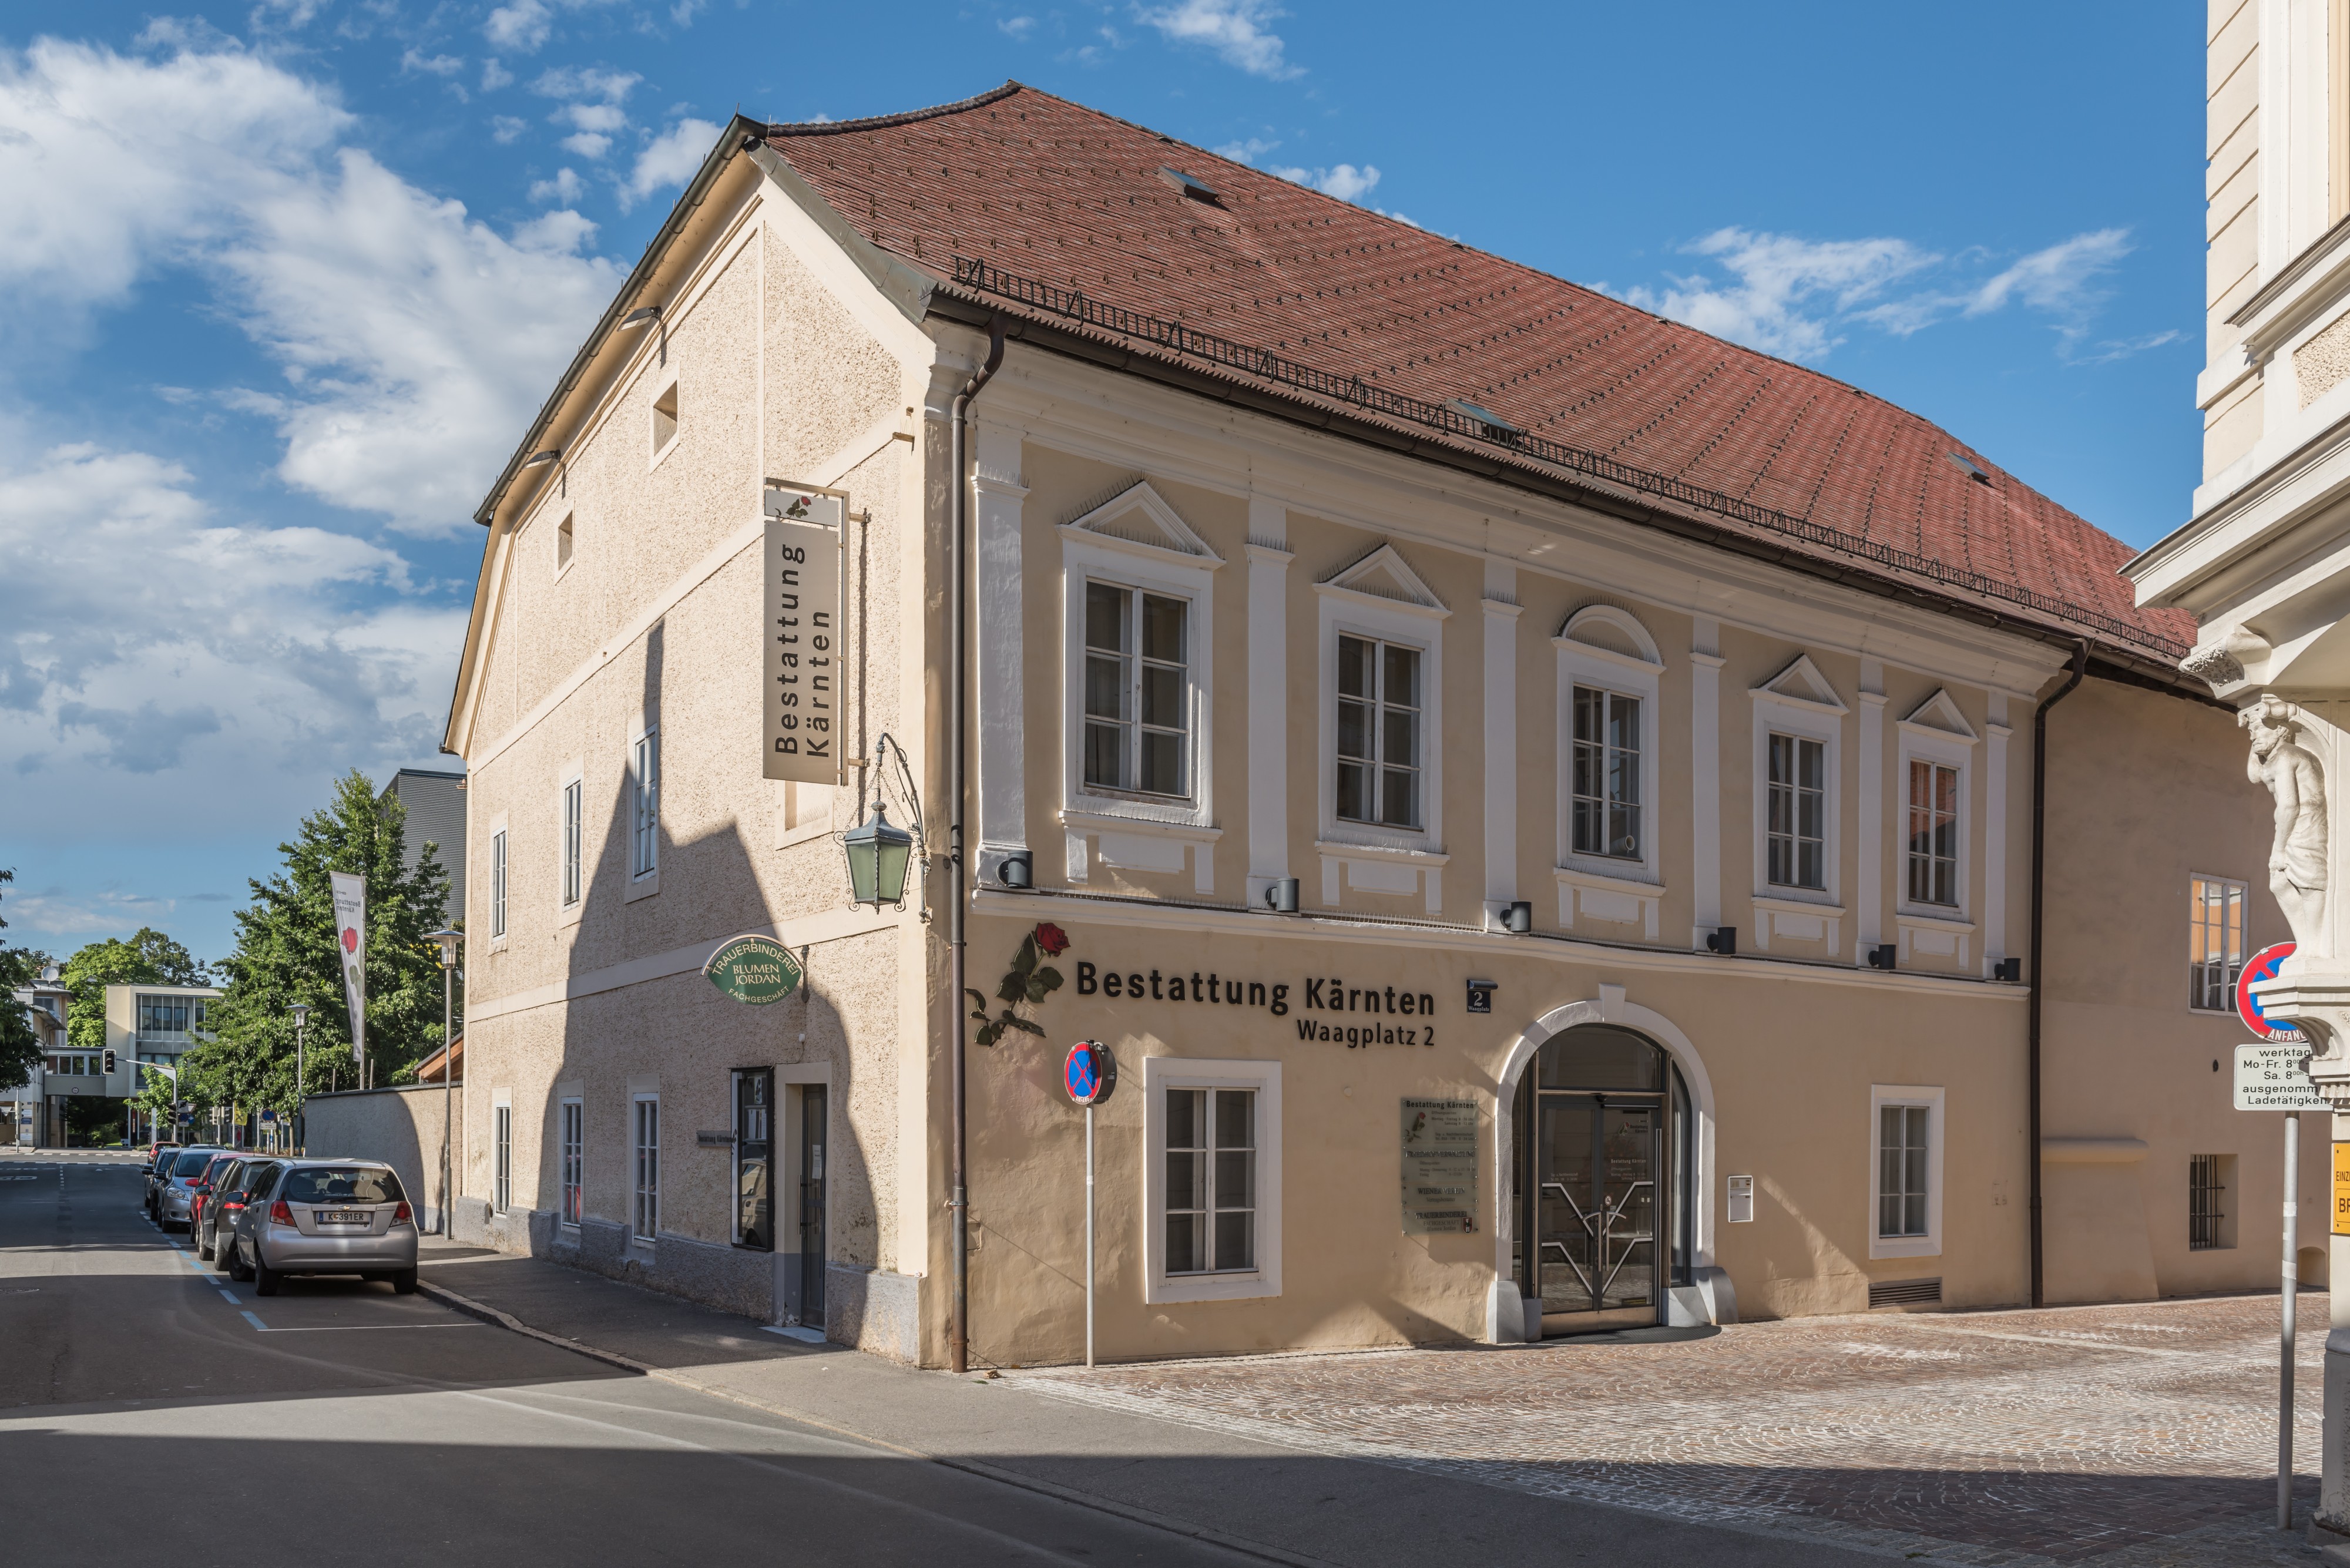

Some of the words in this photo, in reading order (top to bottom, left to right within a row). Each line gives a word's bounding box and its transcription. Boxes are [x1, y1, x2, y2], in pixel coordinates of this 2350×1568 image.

[775, 544, 805, 754] Bestattung
[807, 611, 829, 757] Kärnten
[712, 944, 798, 975] TRAUERBINDEREI
[733, 964, 780, 974] BLUMEN
[735, 975, 781, 986] JORDAN
[728, 986, 790, 1003] FACHGESCHÄFT
[1077, 961, 1290, 1016] Bestattung
[1305, 978, 1435, 1015] Kärnten
[1474, 992, 1483, 1006] 2
[1297, 1019, 1416, 1049] Waagplatz
[1424, 1026, 1435, 1046] 2
[2259, 1048, 2313, 1058] werktag
[2244, 1060, 2281, 1068] Mo-Fr.
[2264, 1071, 2281, 1080] Sa.
[2243, 1086, 2320, 1094] ausgenomm
[1406, 1100, 1444, 1110] Bestattung
